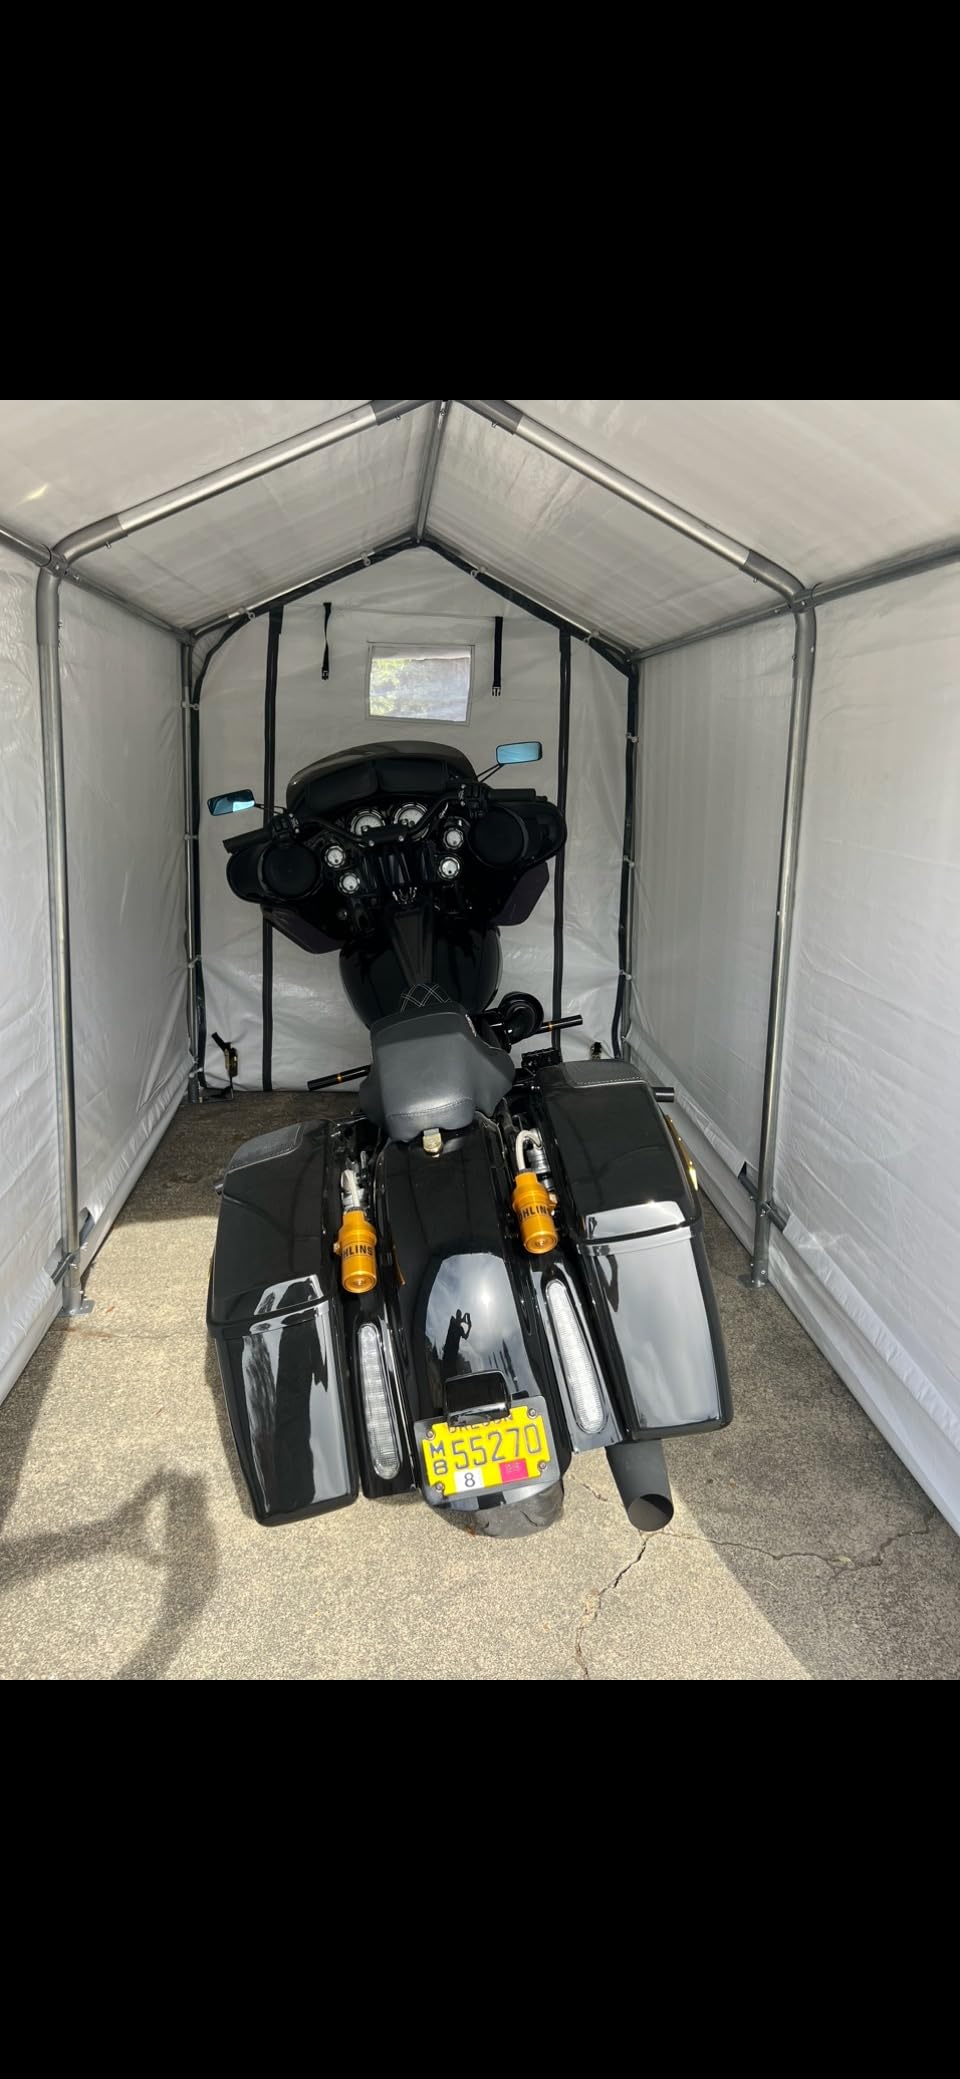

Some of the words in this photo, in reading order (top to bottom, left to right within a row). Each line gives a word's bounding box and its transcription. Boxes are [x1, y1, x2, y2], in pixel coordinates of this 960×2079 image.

[519, 1204, 553, 1222] HLIN
[342, 1244, 374, 1258] HLINS
[451, 1424, 542, 1470] 55270
[464, 1472, 476, 1487] 8
